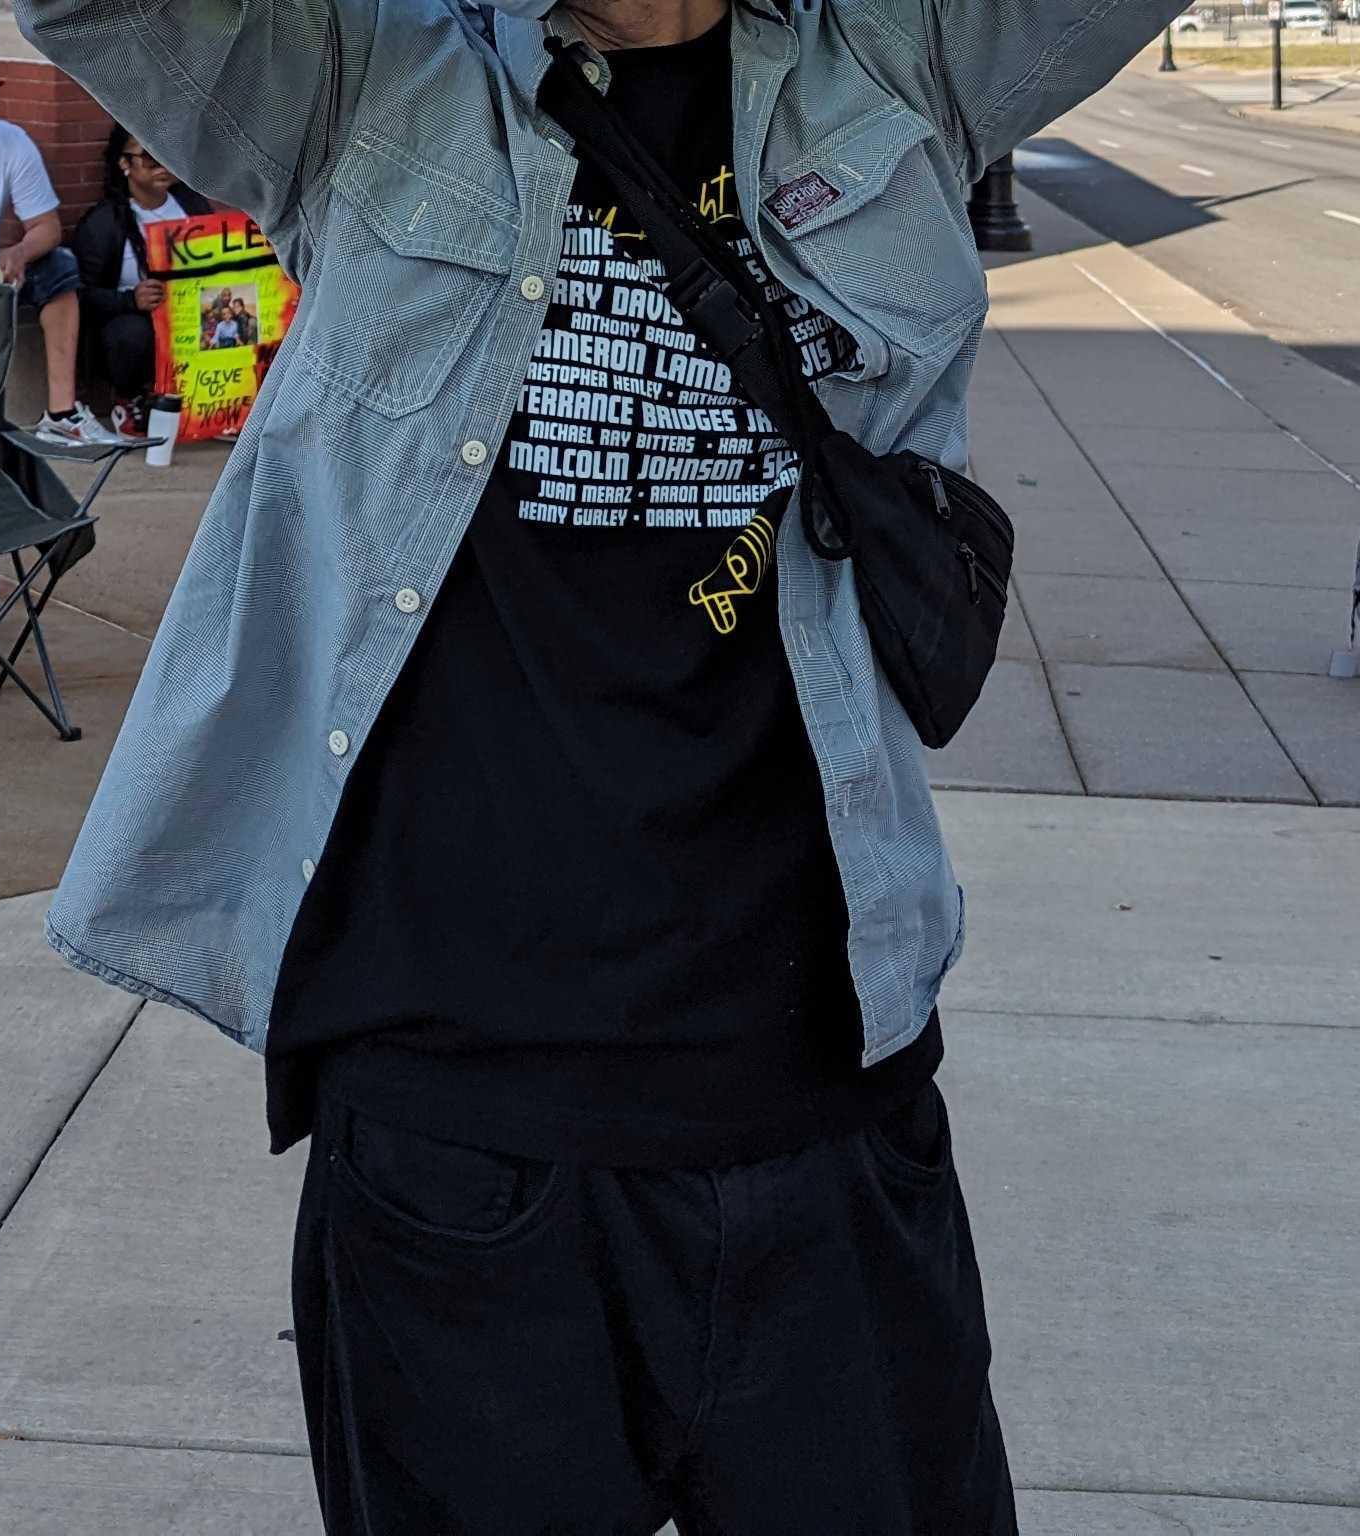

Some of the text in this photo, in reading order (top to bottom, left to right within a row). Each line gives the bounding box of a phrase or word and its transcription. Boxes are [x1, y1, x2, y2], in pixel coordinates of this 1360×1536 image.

[221, 220, 272, 254] LE
[570, 311, 697, 353] ANTHONY BRUNO
[199, 367, 243, 386] GIVE
[612, 374, 663, 401] HENLEY
[654, 348, 733, 394] LAMB
[641, 400, 738, 433] BRIDGES
[528, 419, 595, 445] MICHAEL
[599, 428, 632, 448] RAY
[635, 432, 696, 454] BITTERS
[508, 440, 631, 481] MALCOLM
[636, 454, 745, 481] JOHNSON
[537, 479, 577, 502] JUAN
[649, 484, 699, 504] AARON
[517, 499, 569, 525] KENNY
[572, 507, 629, 527] GURLEY
[645, 507, 702, 528] DARRYL
